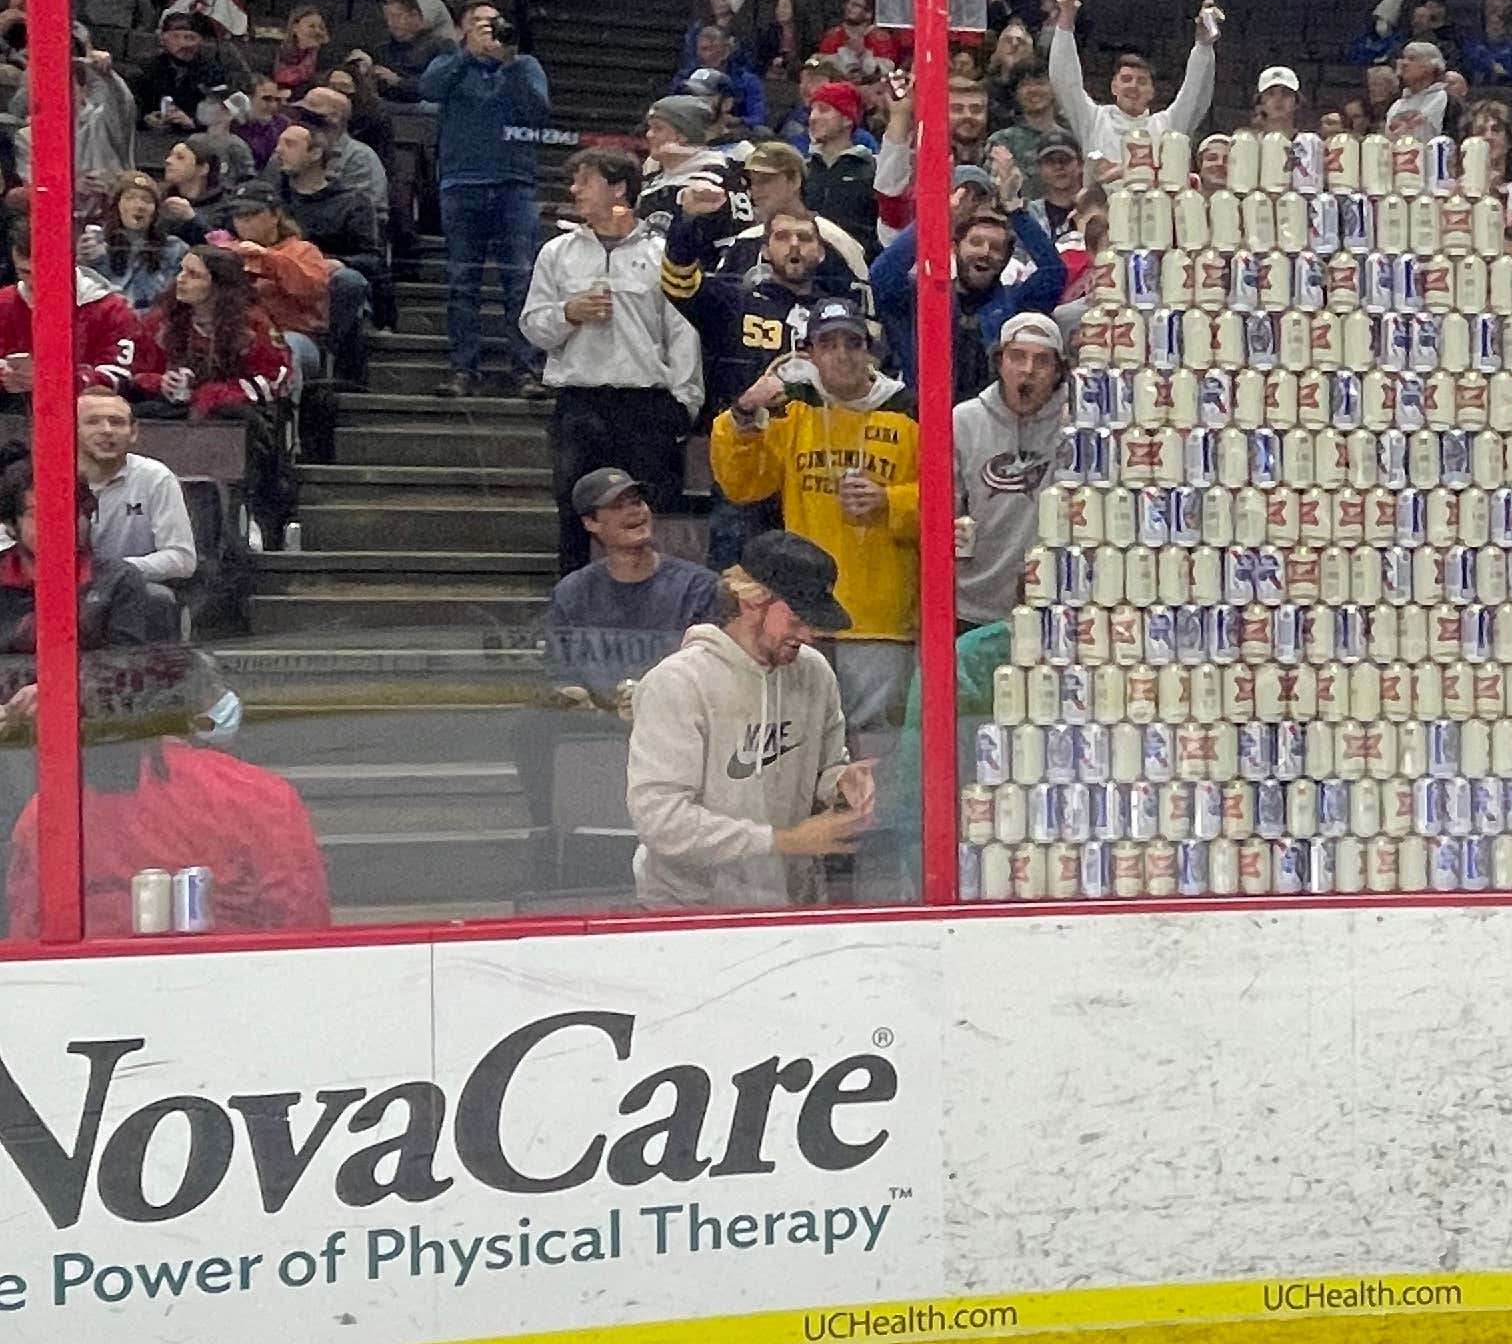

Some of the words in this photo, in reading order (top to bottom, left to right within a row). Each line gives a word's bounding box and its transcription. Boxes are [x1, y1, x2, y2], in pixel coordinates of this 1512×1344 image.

[742, 314, 783, 350] 53
[116, 338, 135, 366] 3
[126, 502, 144, 516] M
[742, 720, 793, 753] NKE
[54, 1253, 263, 1306] Power
[278, 1231, 346, 1287] of
[366, 1209, 621, 1286] Physical
[1263, 1280, 1463, 1311] UCHealth.com
[803, 1302, 1019, 1341] UCHealth.com
